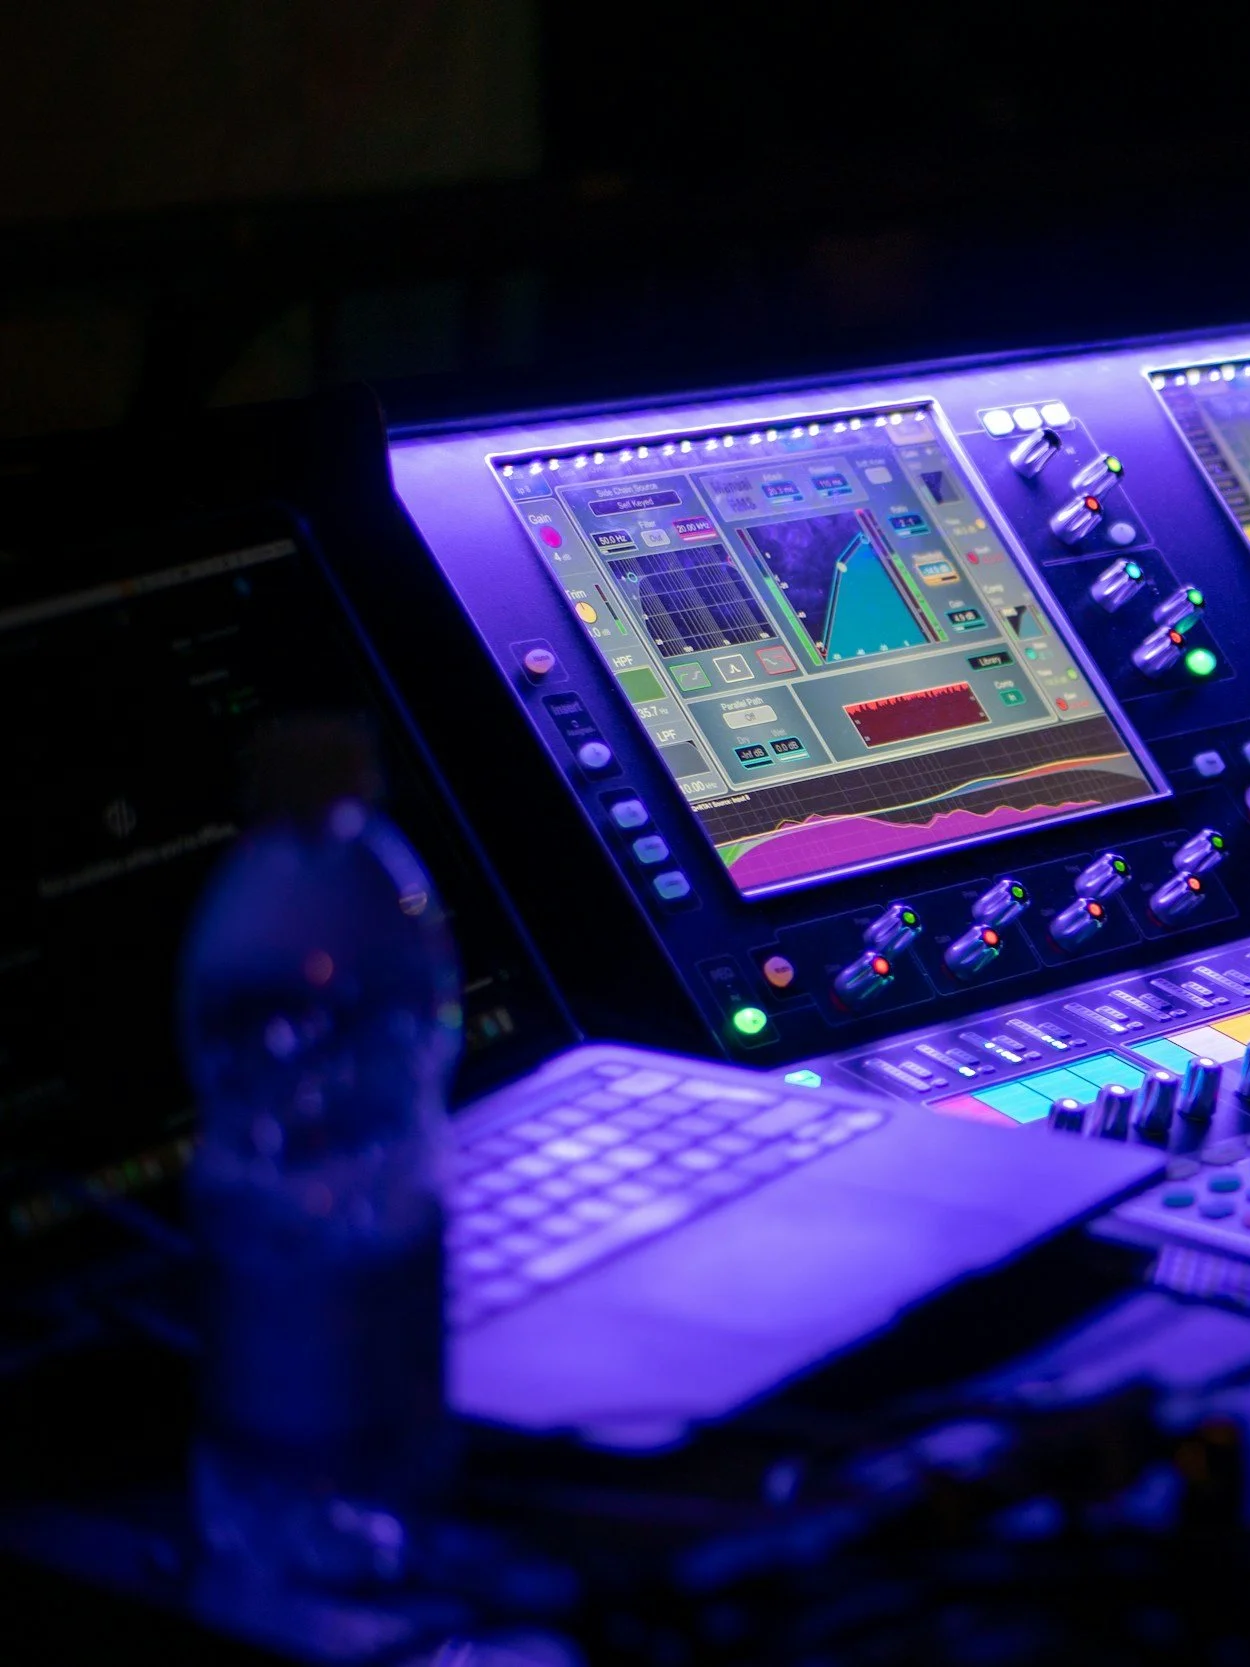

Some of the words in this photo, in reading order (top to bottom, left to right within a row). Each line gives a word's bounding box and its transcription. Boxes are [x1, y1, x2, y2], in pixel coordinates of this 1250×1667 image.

[528, 514, 552, 524] Gain
[676, 524, 696, 534] 20.00
[696, 521, 711, 530] kHz
[599, 536, 616, 546] 50.0
[616, 534, 628, 542] Hz
[612, 655, 634, 668] HPF
[979, 656, 1001, 667] Library
[720, 699, 748, 711] Parallel
[745, 696, 764, 706] Path
[656, 729, 677, 742] LPF
[774, 743, 788, 753] 0.0
[788, 741, 800, 750] dB
